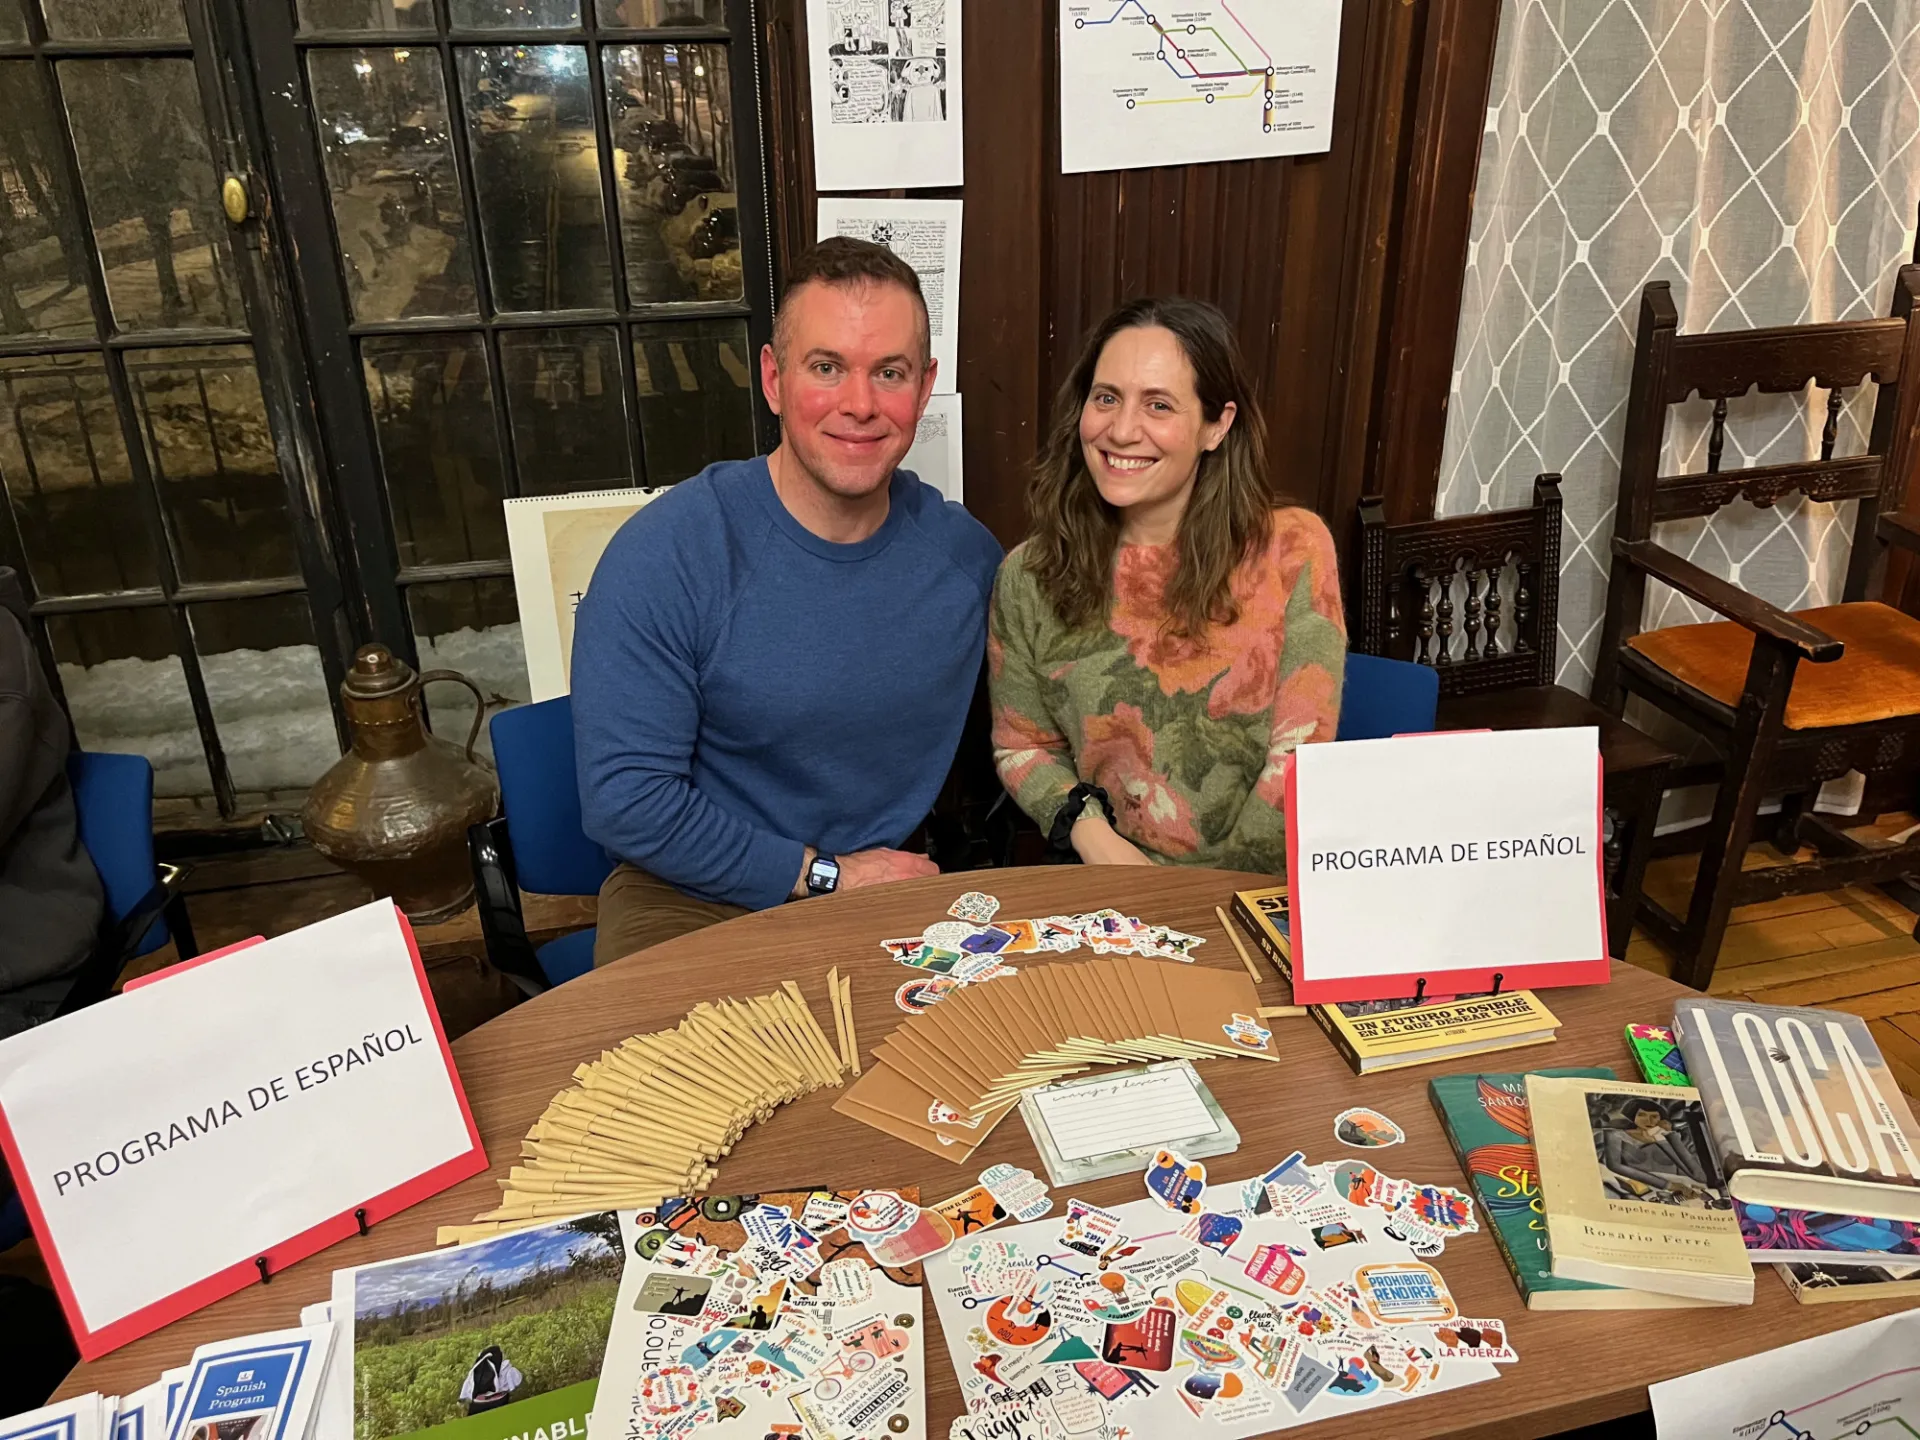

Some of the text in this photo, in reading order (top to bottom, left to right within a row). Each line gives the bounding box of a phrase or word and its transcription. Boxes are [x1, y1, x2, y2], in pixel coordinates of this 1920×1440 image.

[1311, 834, 1586, 872] PROGRAMA DE ESPAÑOL
[1260, 937, 1293, 981] SE BUSC
[973, 964, 1004, 981] VIDA
[1352, 997, 1528, 1032] UN FUTURO POSIBLE
[1358, 1004, 1533, 1038] EN EL QUE DESEAR VIVIR
[1691, 1008, 1920, 1181] LOCA
[53, 1023, 423, 1196] PROGRAMA DE ESPAÑOL
[982, 1164, 1016, 1185] ERES
[1163, 1168, 1180, 1197] FELICIDAD
[811, 1198, 845, 1209] Crecer
[1267, 1184, 1281, 1209] VALIEN
[1018, 1198, 1052, 1219] PIENSAS
[1609, 1203, 1735, 1223] Papeles de Pandora
[1084, 1231, 1106, 1245] Más
[1583, 1225, 1712, 1247] Rosario Ferré
[1119, 1259, 1156, 1271] Intermediate
[947, 1285, 970, 1293] Elemen
[1368, 1273, 1431, 1288] PROHIBIDO
[1211, 1290, 1229, 1307] SER
[1373, 1285, 1438, 1301] RENDIRSE
[1131, 1299, 1154, 1308] imites
[1323, 1301, 1348, 1321] Prueba
[782, 1314, 807, 1330] Lucha
[1065, 1314, 1091, 1324] DESEO
[1476, 1320, 1502, 1328] HACE
[787, 1345, 819, 1365] sueños
[793, 1337, 826, 1358] por tus
[1438, 1347, 1513, 1359] LA FUERZA
[718, 1356, 740, 1364] CADA
[718, 1364, 732, 1373] DÍA
[1001, 1365, 1009, 1373] El
[1009, 1365, 1031, 1381] siempre
[216, 1380, 267, 1397] Spanish
[827, 1361, 892, 1416] LA VIDA ES COMO
[208, 1395, 265, 1411] Program
[852, 1381, 903, 1427] EQUILIBRIO
[867, 1401, 893, 1425] PUEDES
[889, 1386, 912, 1405] PARAR
[1732, 1417, 1767, 1434] Elementary
